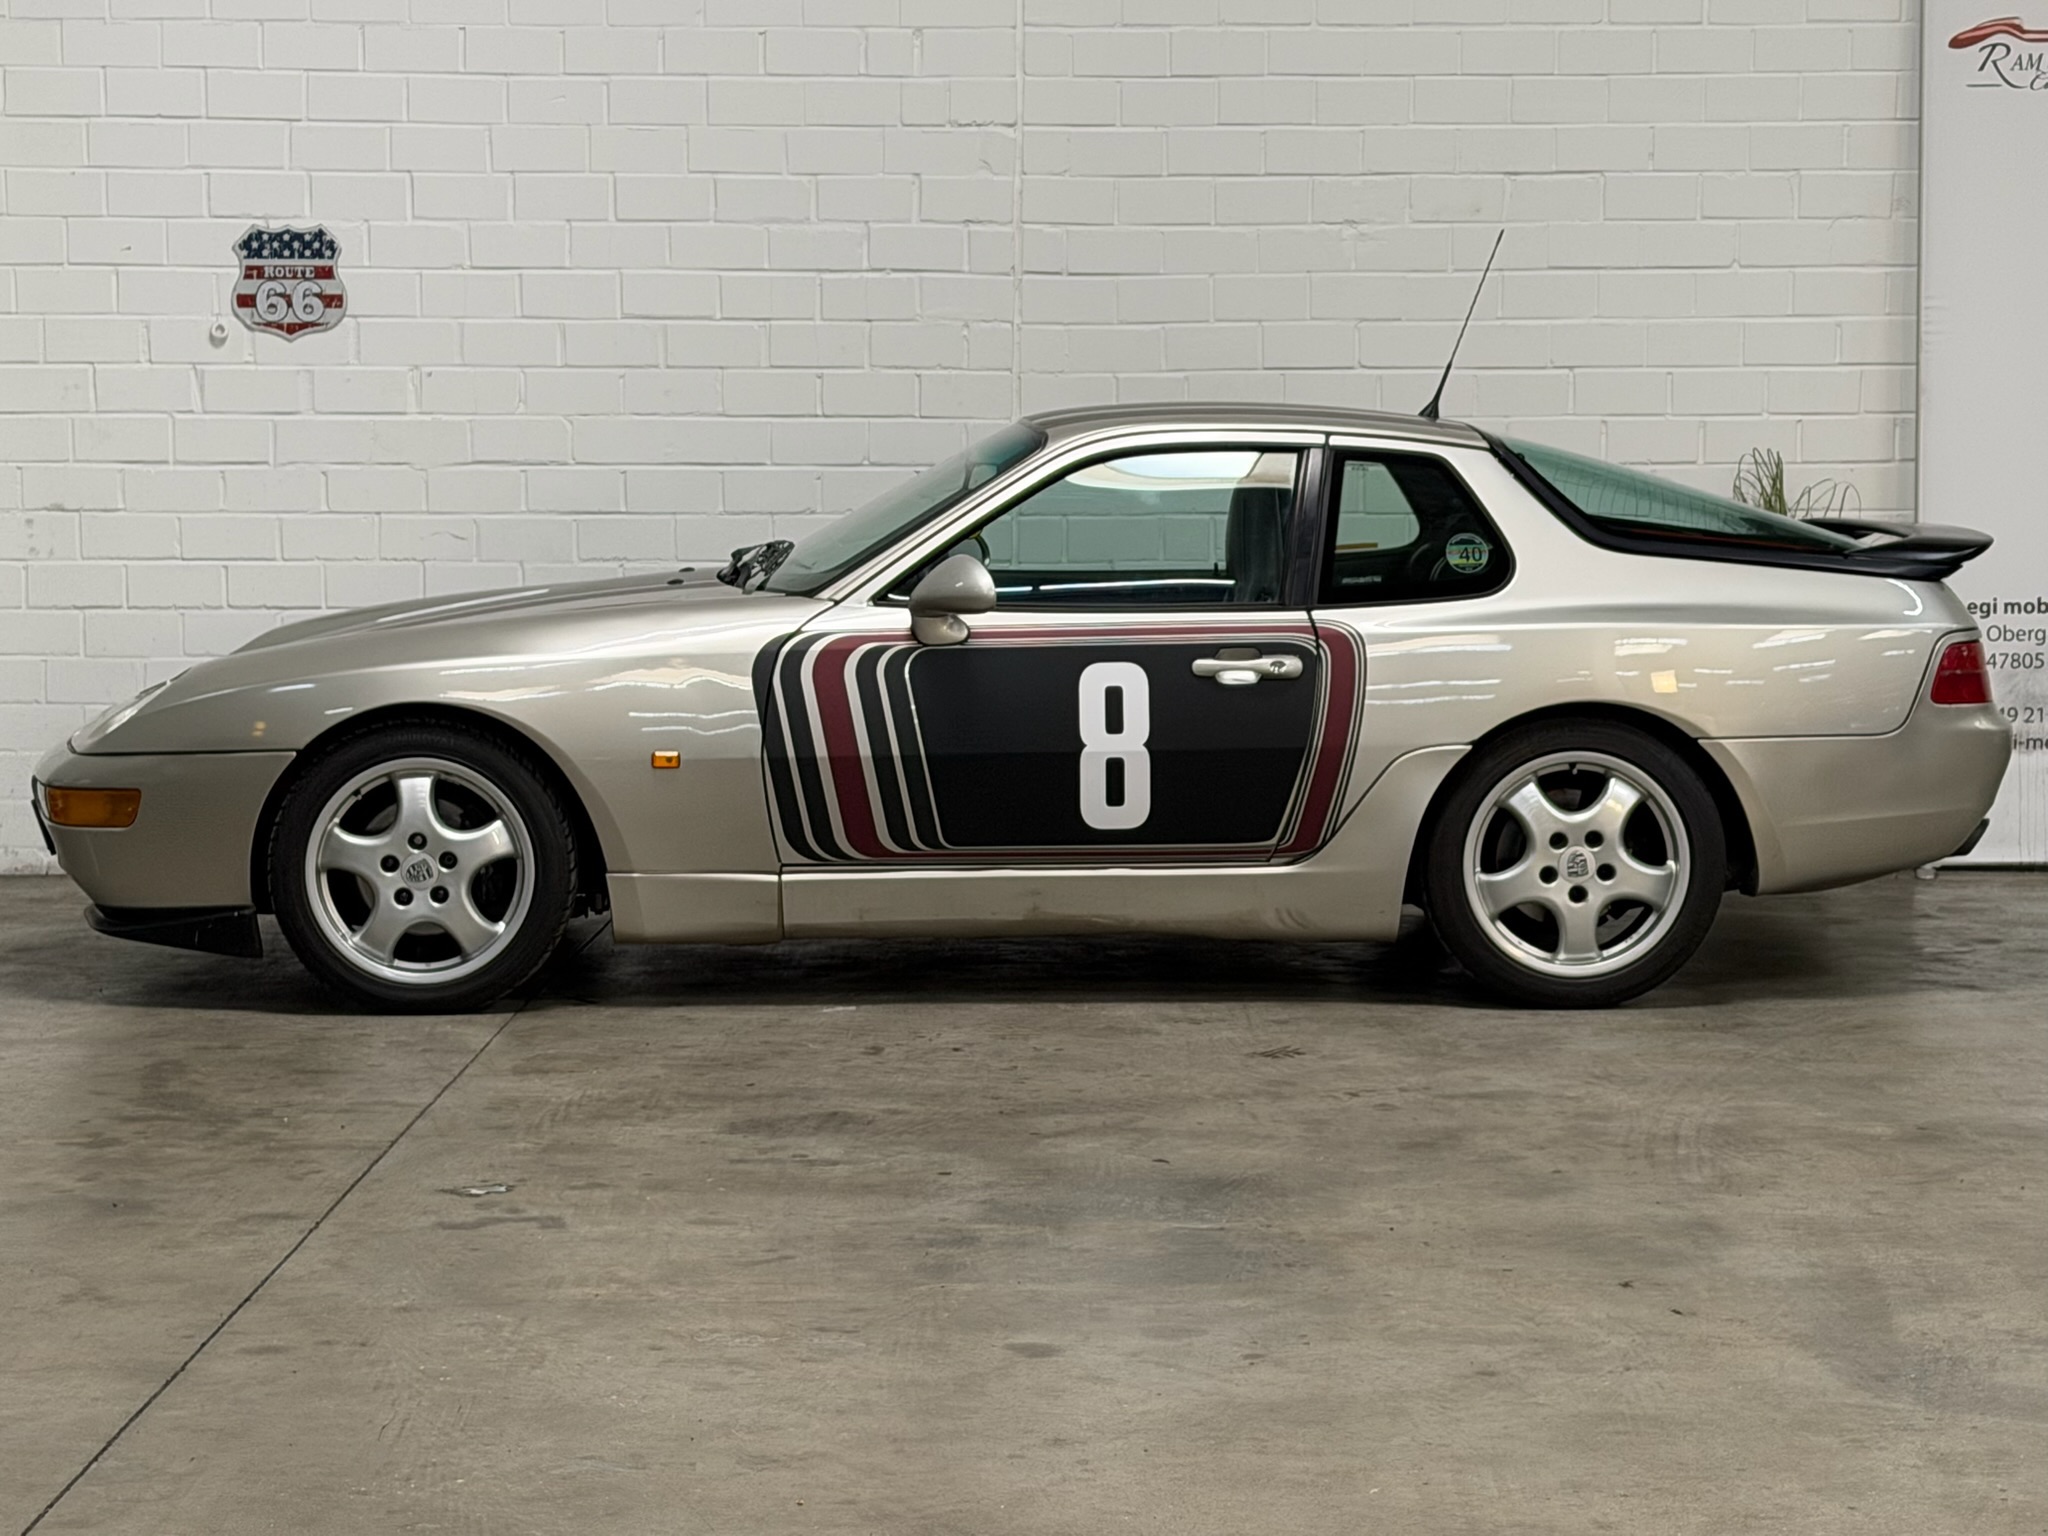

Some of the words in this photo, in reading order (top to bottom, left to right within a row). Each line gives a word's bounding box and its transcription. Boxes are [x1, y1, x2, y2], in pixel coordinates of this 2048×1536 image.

[1978, 42, 2048, 89] RAM
[264, 266, 315, 278] ROUTE
[256, 280, 325, 323] 66
[1459, 546, 1482, 562] 40
[1986, 624, 2047, 646] Oberg
[1986, 652, 2045, 670] 47805
[2023, 706, 2048, 724] 21
[1078, 661, 1151, 830] 8
